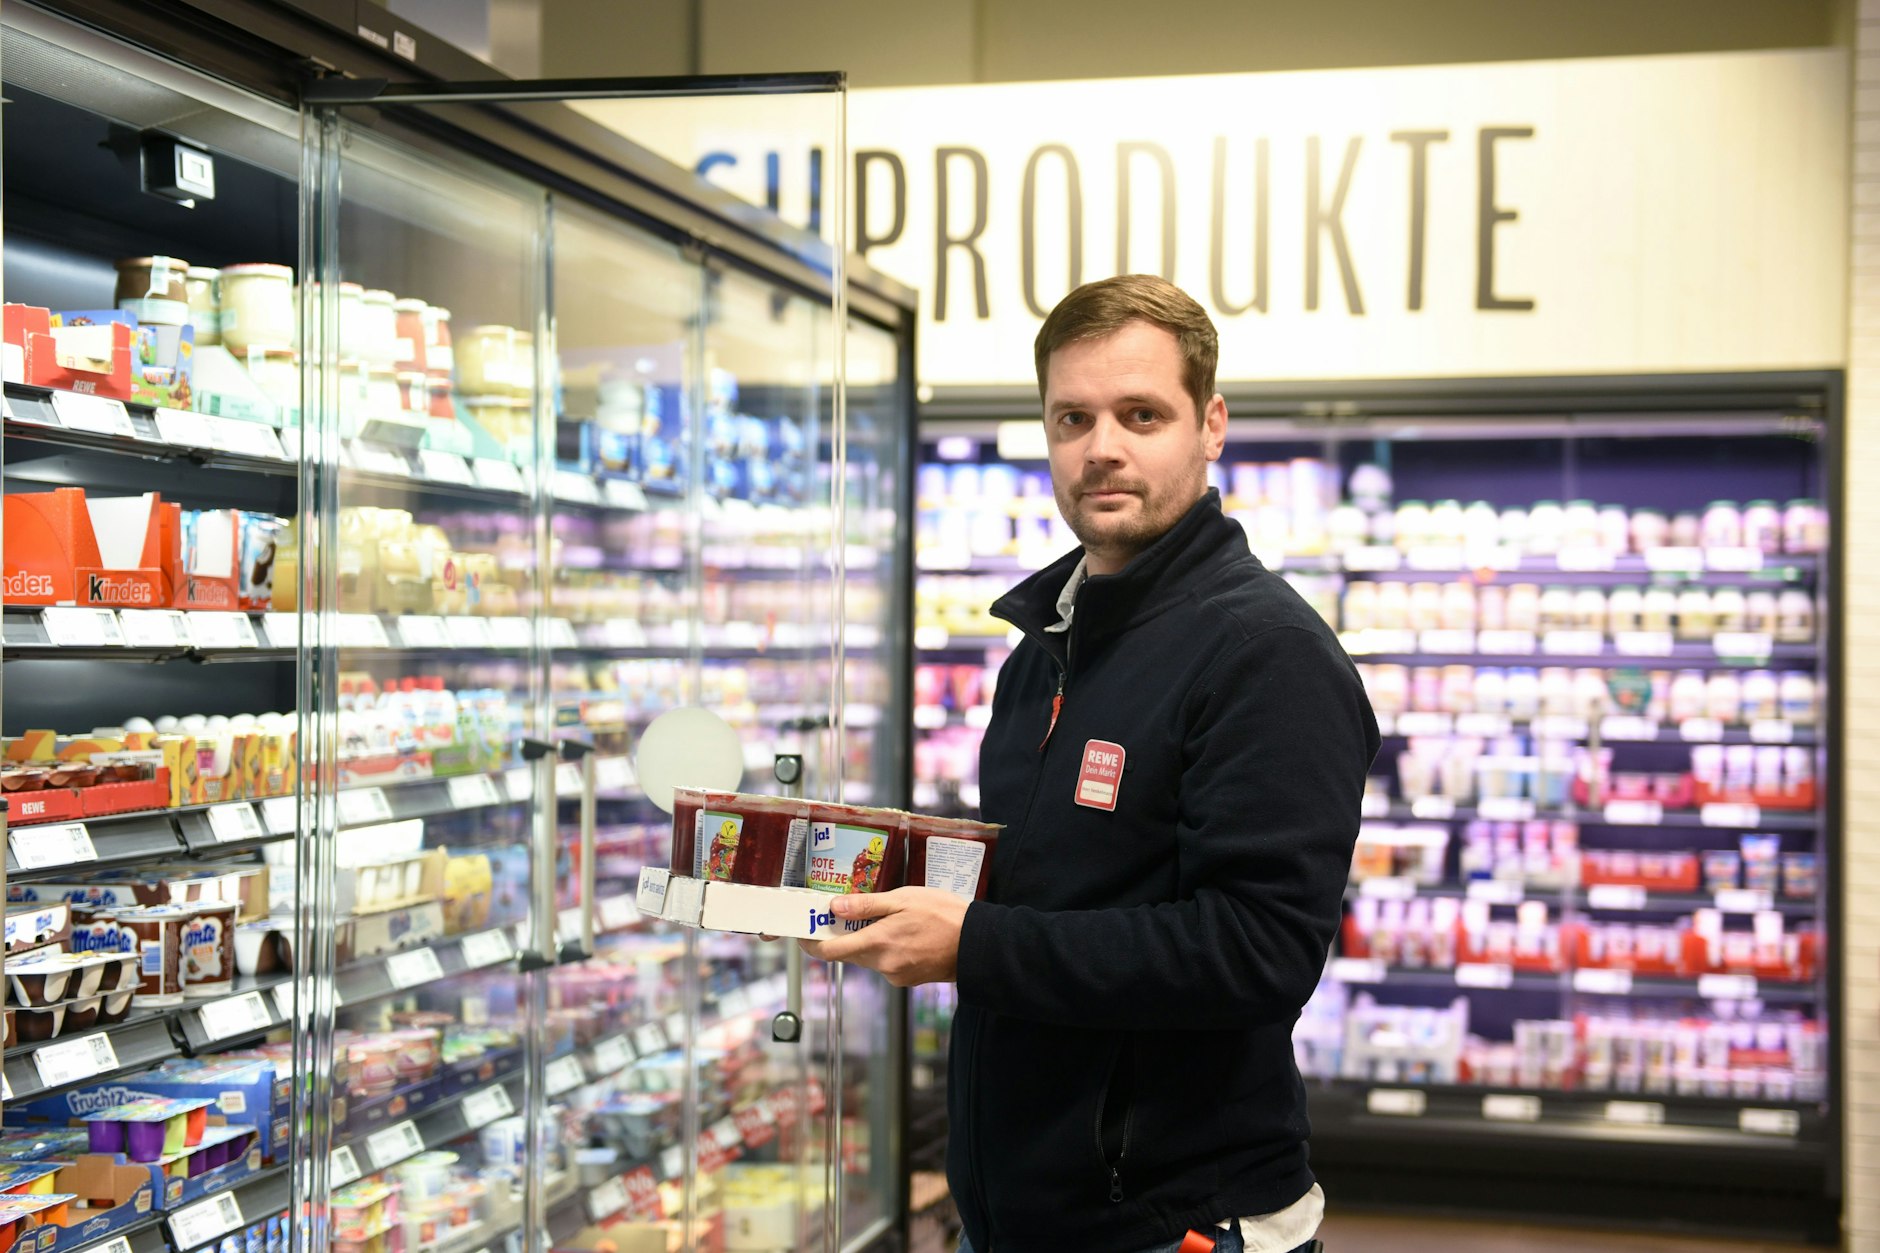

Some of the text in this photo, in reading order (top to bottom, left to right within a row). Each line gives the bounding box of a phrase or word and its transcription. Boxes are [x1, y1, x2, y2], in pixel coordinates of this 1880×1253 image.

[694, 126, 1535, 322] PRODUKTE
[72, 380, 96, 394] REWE
[3, 570, 53, 596] nder
[1088, 750, 1119, 767] REWE
[1086, 765, 1098, 775] Dein
[22, 801, 45, 815] REWE
[814, 827, 830, 847] ja!
[811, 857, 835, 870] ROTE
[810, 869, 848, 885] GRÜTZE
[809, 908, 836, 934] ja!
[183, 923, 216, 948] onte
